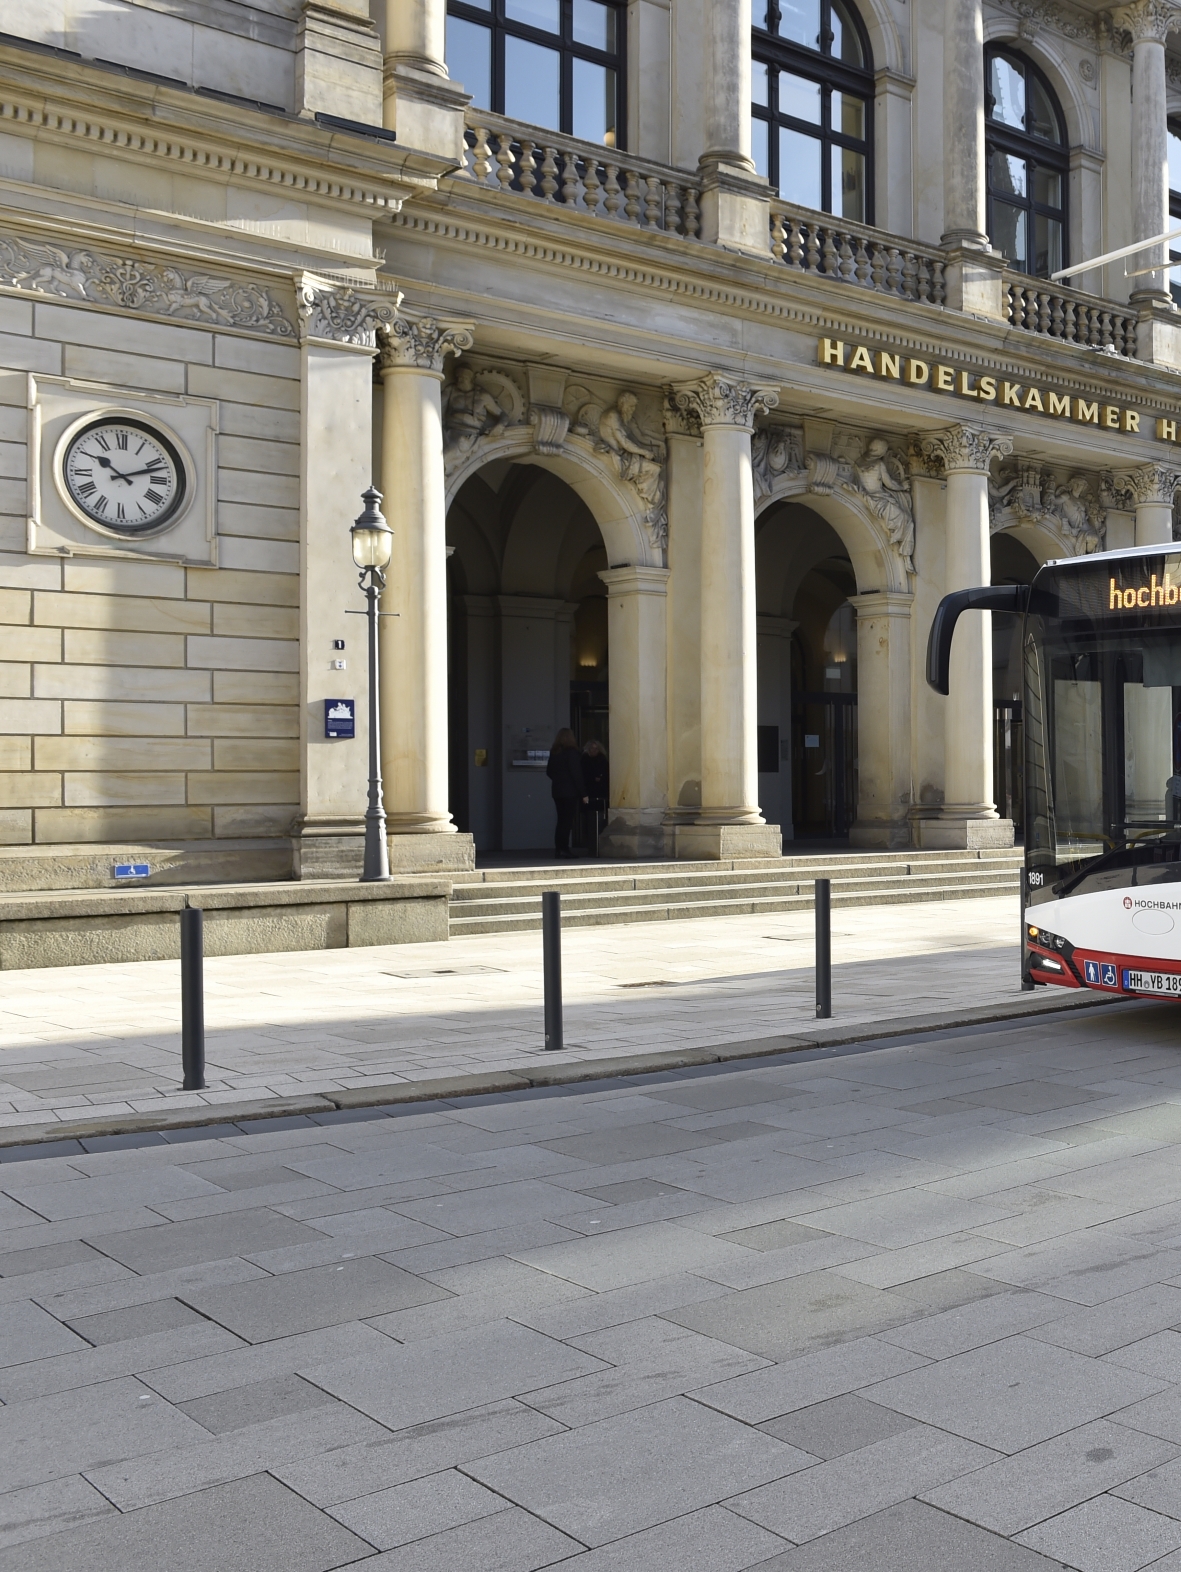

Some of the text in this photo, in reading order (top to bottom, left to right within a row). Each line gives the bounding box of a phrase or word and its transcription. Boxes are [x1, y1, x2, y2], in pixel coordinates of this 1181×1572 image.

[818, 338, 1140, 433] HANDELSKAMMER
[1028, 871, 1044, 886] 1891
[1129, 972, 1143, 988] HH
[1150, 974, 1163, 990] YB
